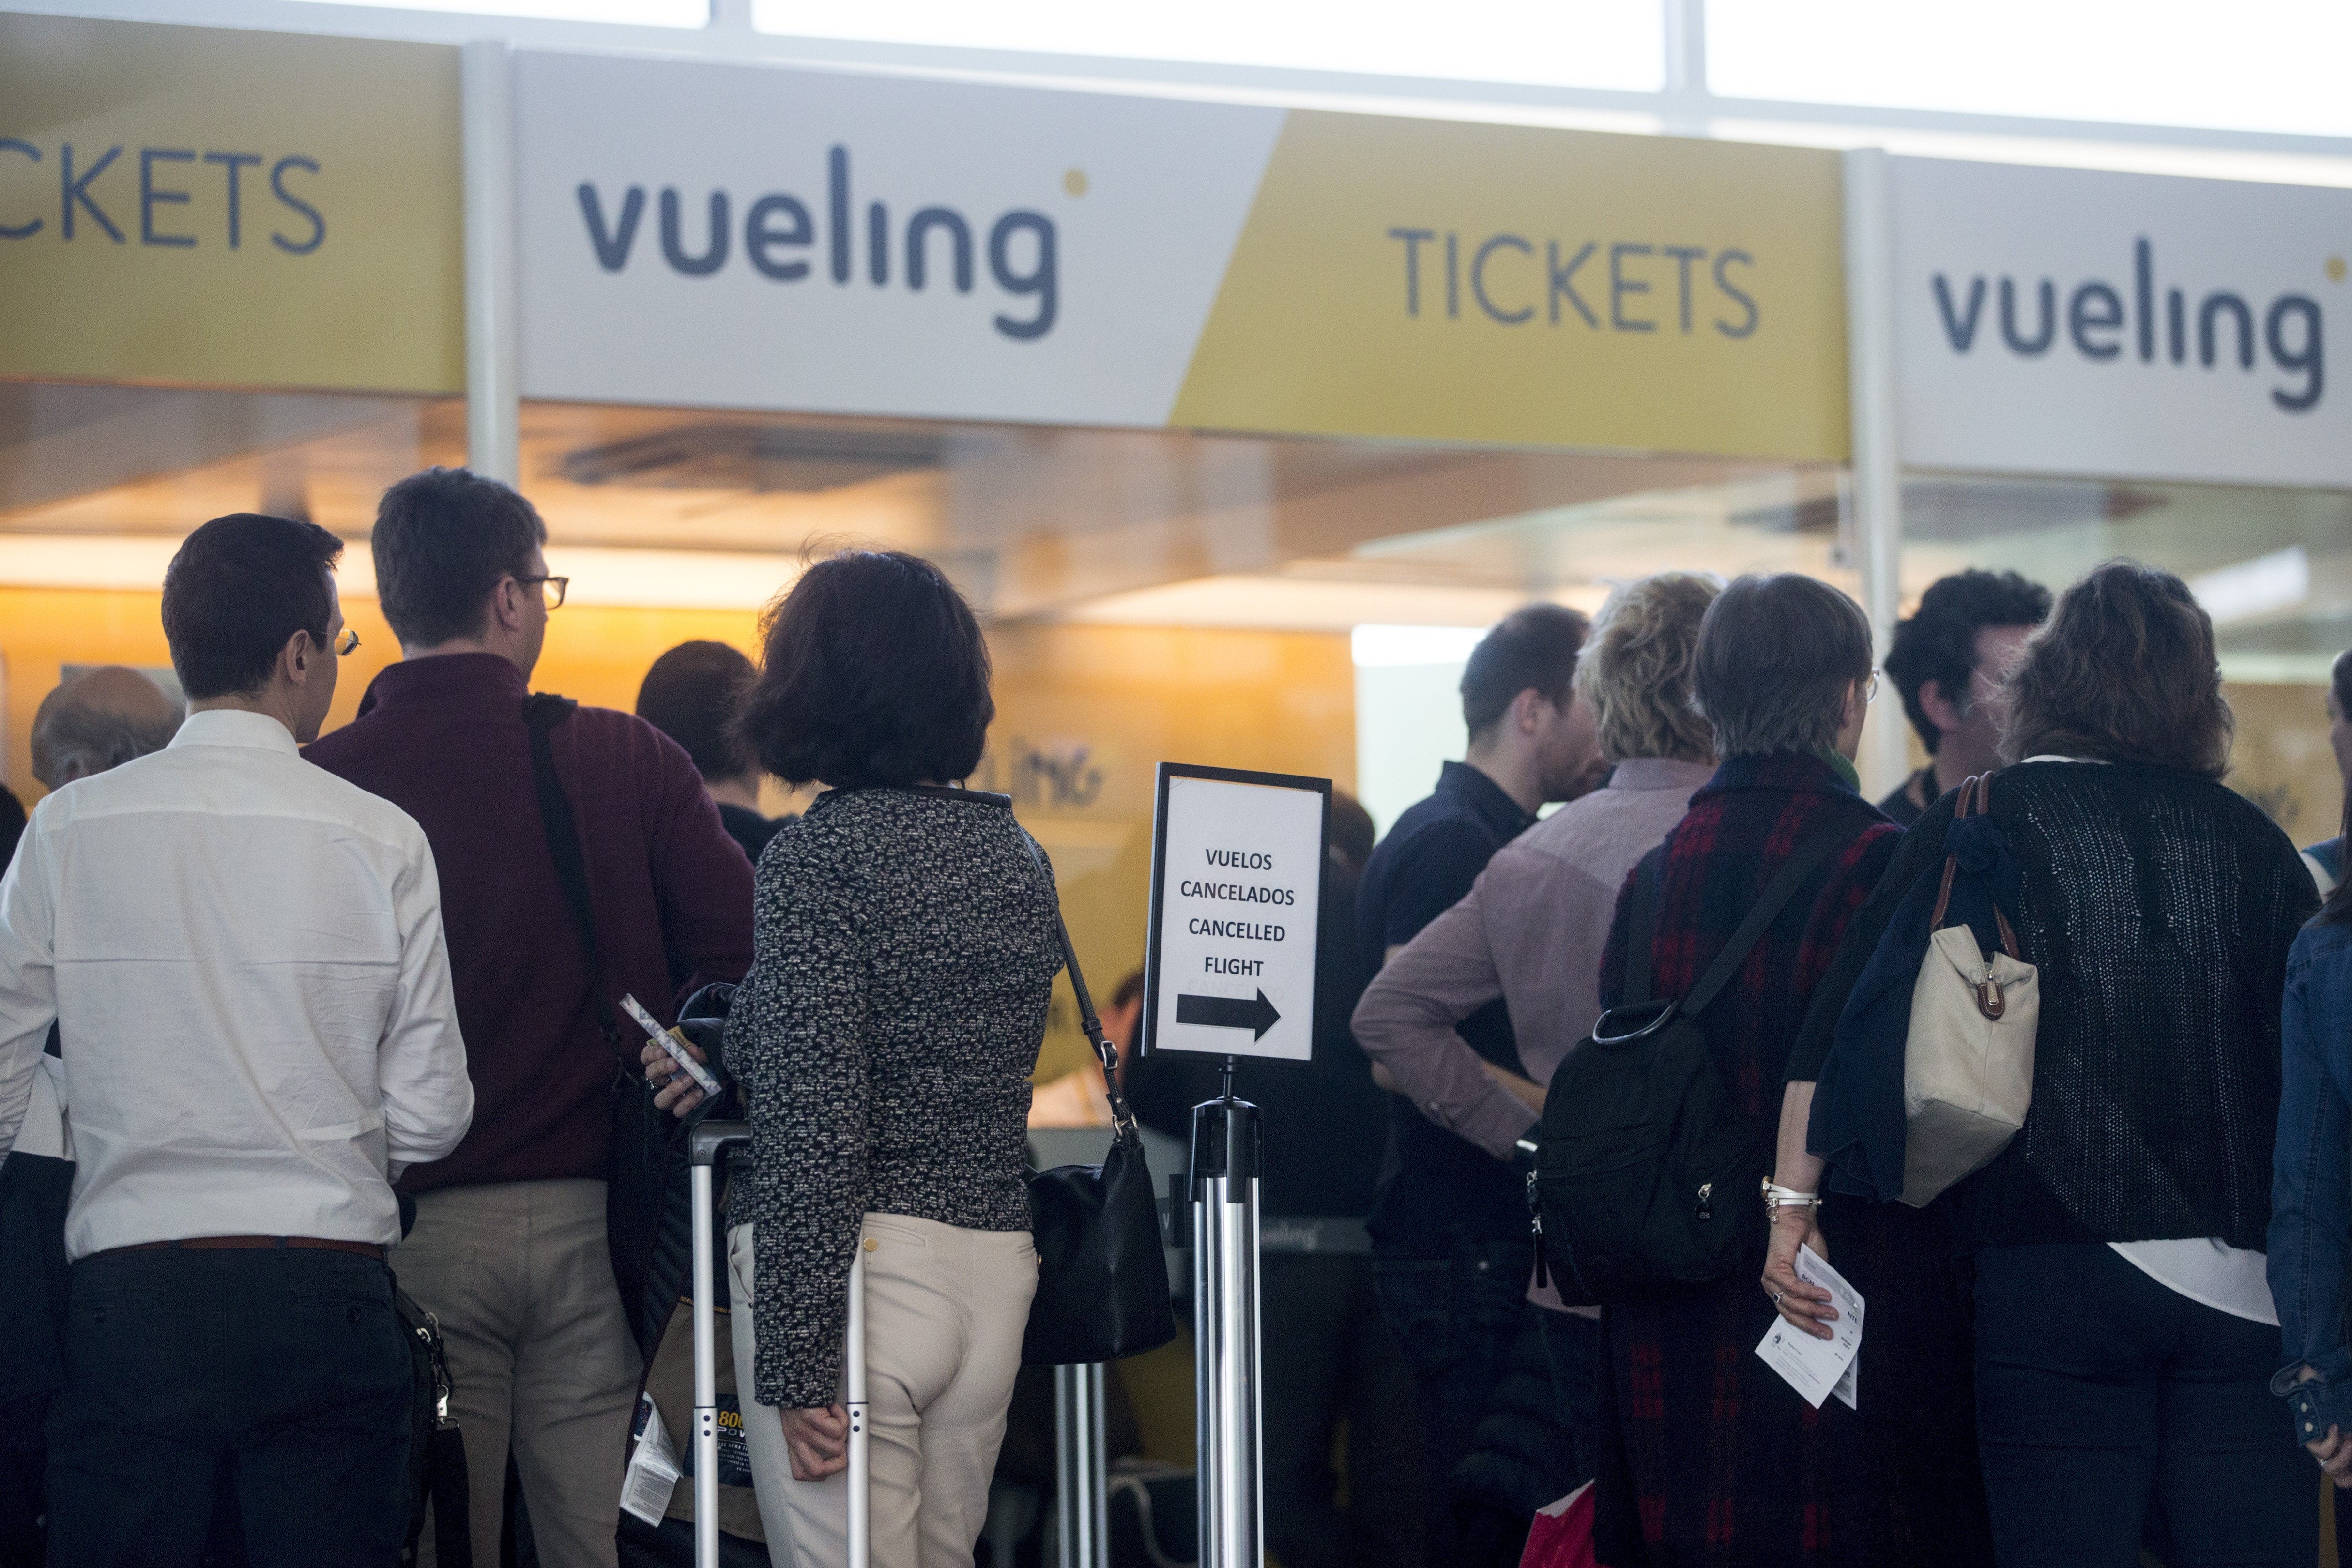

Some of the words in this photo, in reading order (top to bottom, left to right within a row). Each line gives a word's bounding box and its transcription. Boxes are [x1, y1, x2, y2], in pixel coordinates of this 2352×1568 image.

[0, 137, 325, 256] CKETS
[576, 144, 1059, 342] vueling
[1387, 227, 1759, 339] TICKETS
[1932, 237, 2325, 414] vueling
[1180, 880, 1295, 906] CANCELADOS
[1206, 849, 1272, 871] VUELOS
[1189, 918, 1285, 942] CANCELLED
[1205, 956, 1264, 977] FLIGHT
